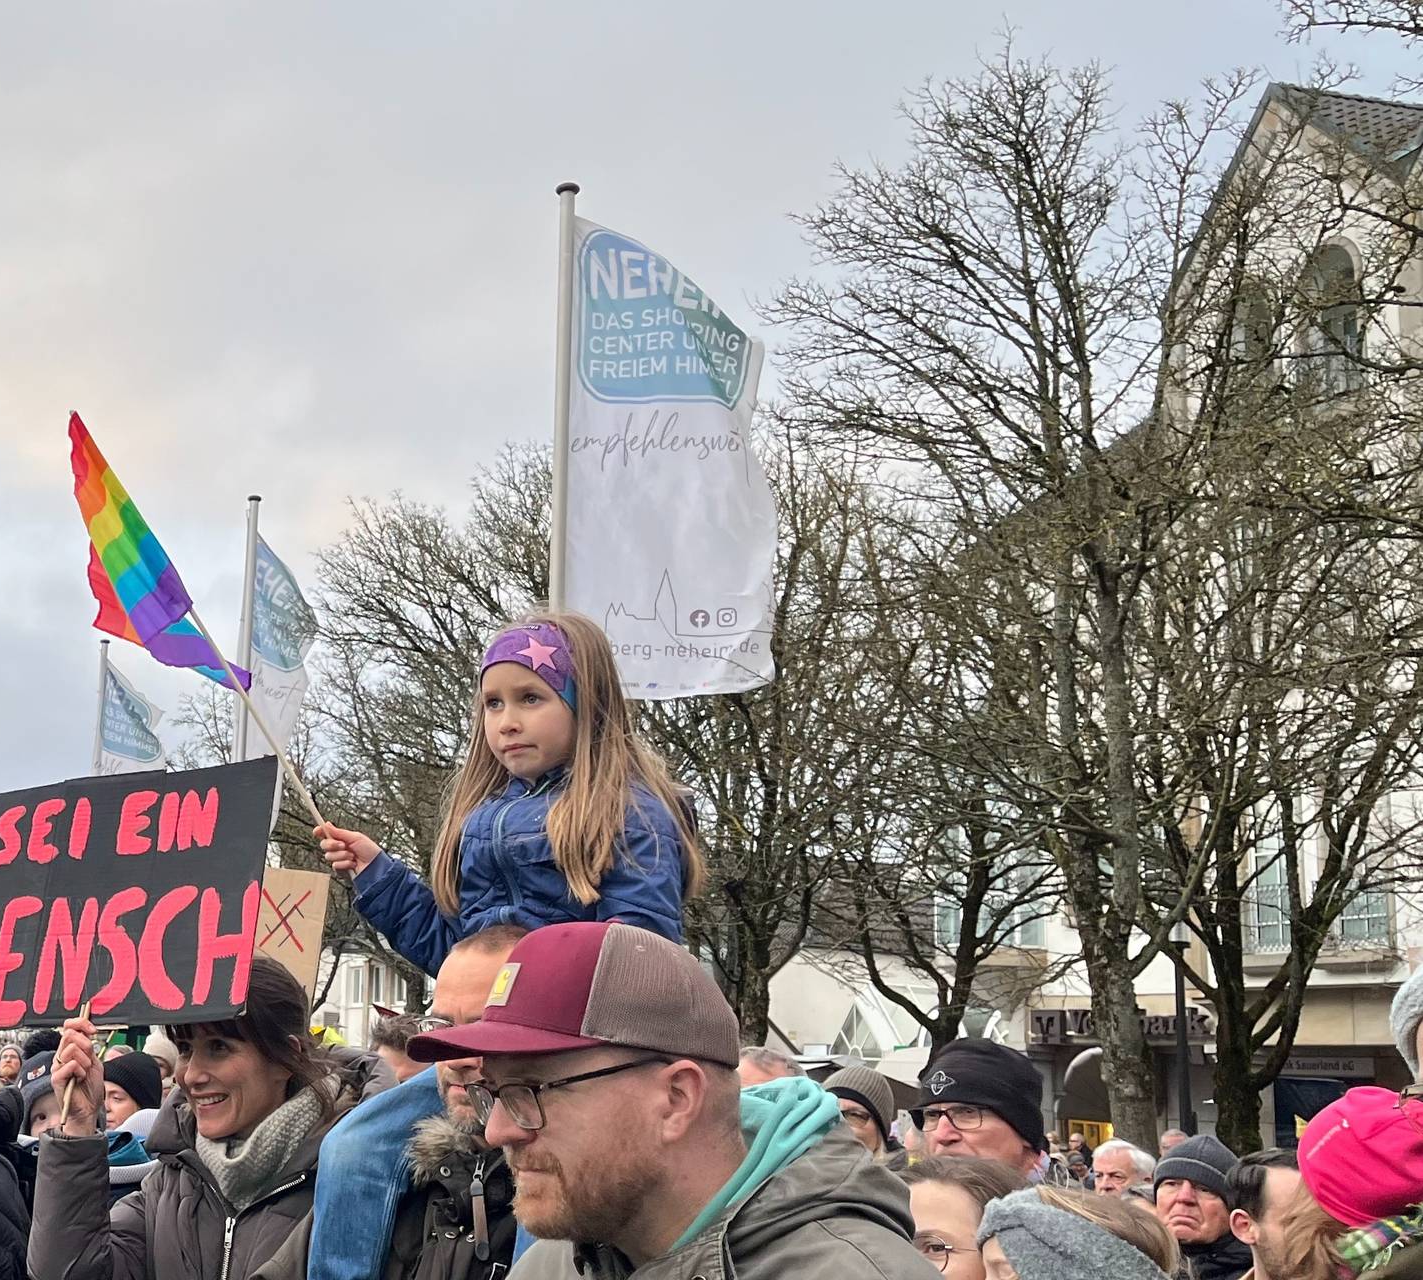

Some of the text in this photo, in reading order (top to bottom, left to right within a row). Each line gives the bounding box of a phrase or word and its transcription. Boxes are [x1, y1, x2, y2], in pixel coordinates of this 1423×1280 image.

[592, 307, 741, 352] DAS SHOPING
[589, 331, 738, 375] CENTER UNER
[589, 355, 666, 379] FREIEM
[116, 787, 219, 856] EIN
